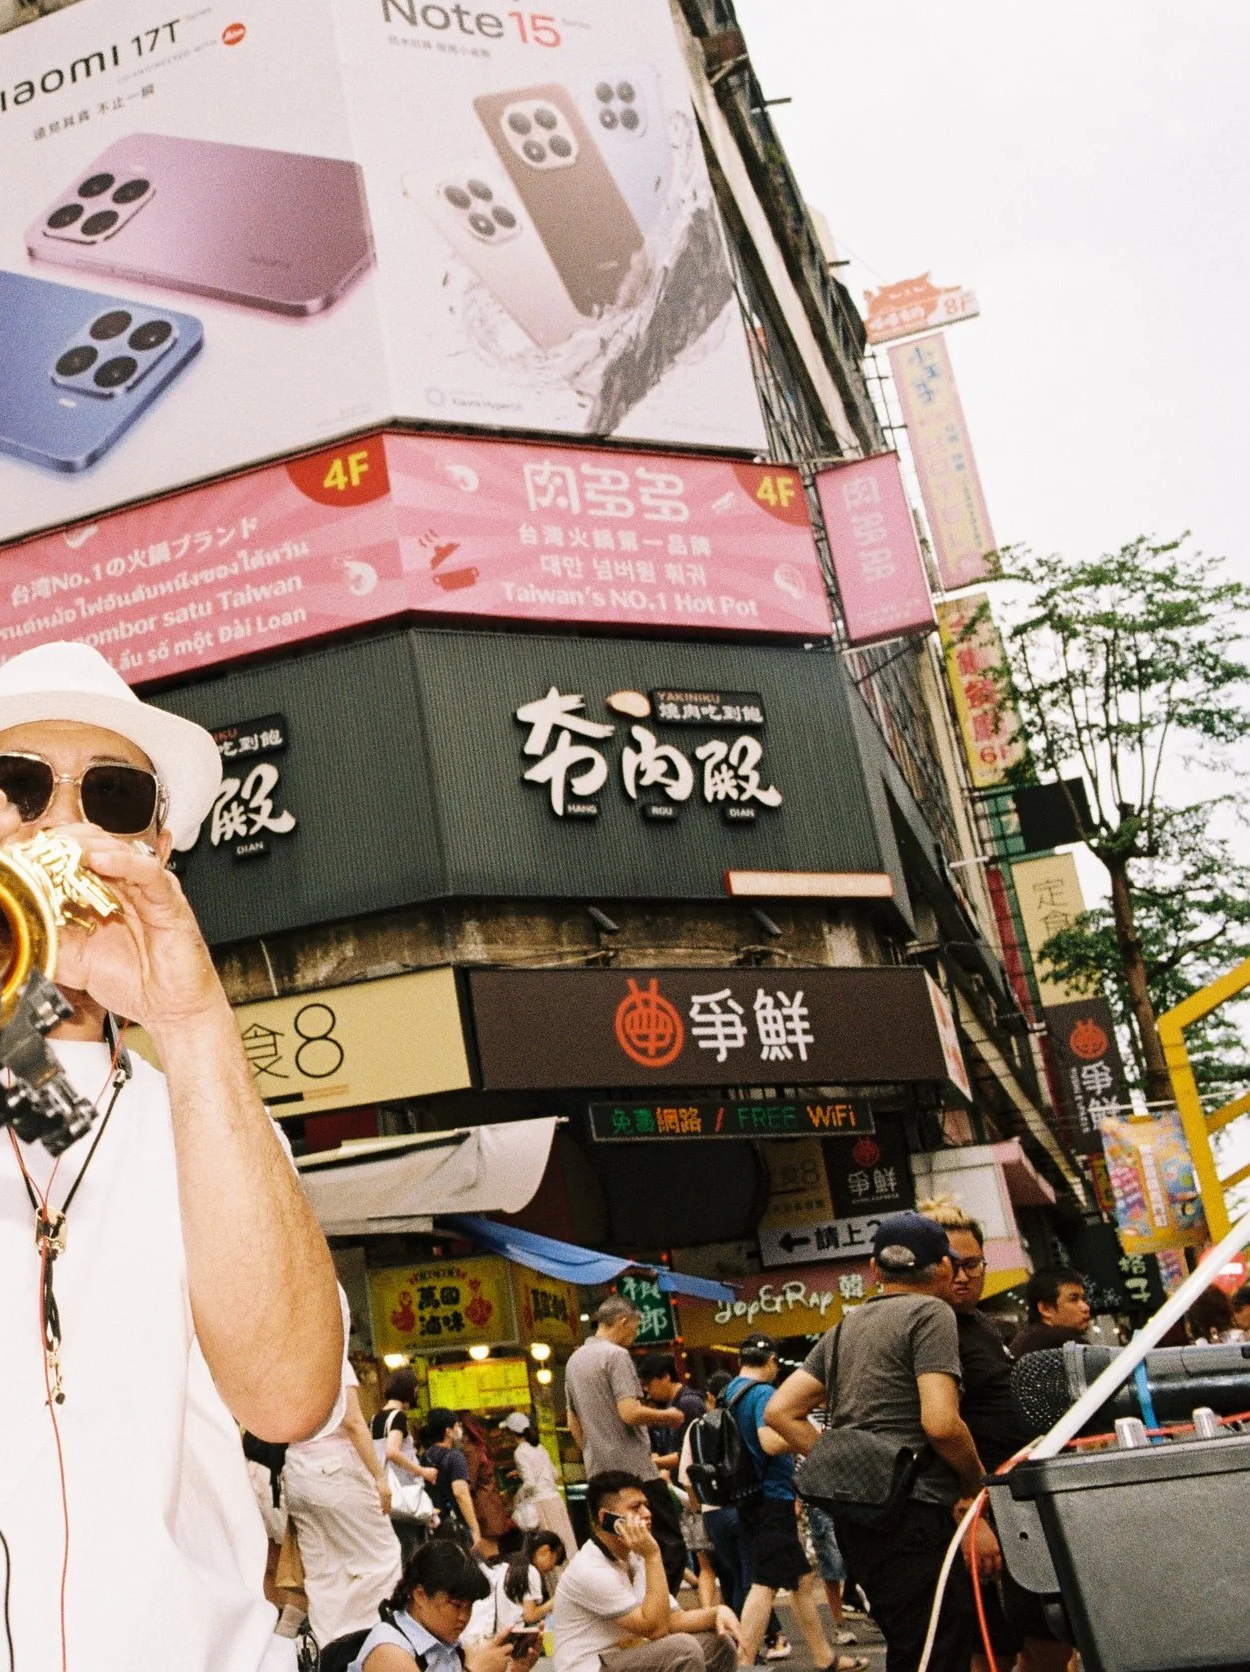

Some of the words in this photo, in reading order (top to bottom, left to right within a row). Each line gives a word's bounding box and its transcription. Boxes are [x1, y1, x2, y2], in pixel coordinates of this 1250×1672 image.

[131, 19, 180, 57] 17T
[382, 0, 504, 39] Note
[508, 11, 562, 48] 15
[322, 451, 371, 491] 4F
[523, 459, 690, 523] 肉多多
[755, 475, 795, 509] 4F
[539, 554, 584, 579] 대만
[162, 600, 213, 628] satu
[215, 574, 303, 612] Taiwan
[503, 581, 607, 608] Taiwan's
[609, 588, 668, 613] NO.1
[674, 593, 715, 615] Hot
[720, 595, 759, 618] Pot
[256, 607, 308, 634] Loan
[656, 692, 721, 704] YAKINIKU
[210, 762, 297, 848] 殿
[567, 803, 598, 815] HANG
[651, 806, 673, 816] ROU
[729, 808, 755, 818] DIAN
[236, 841, 264, 856] DIAN
[688, 988, 815, 1063] 爭鮮
[611, 1106, 703, 1136] 免費網路
[737, 1106, 797, 1129] FREE
[806, 1104, 856, 1128] WiFi
[847, 1165, 900, 1198] 爭鮮
